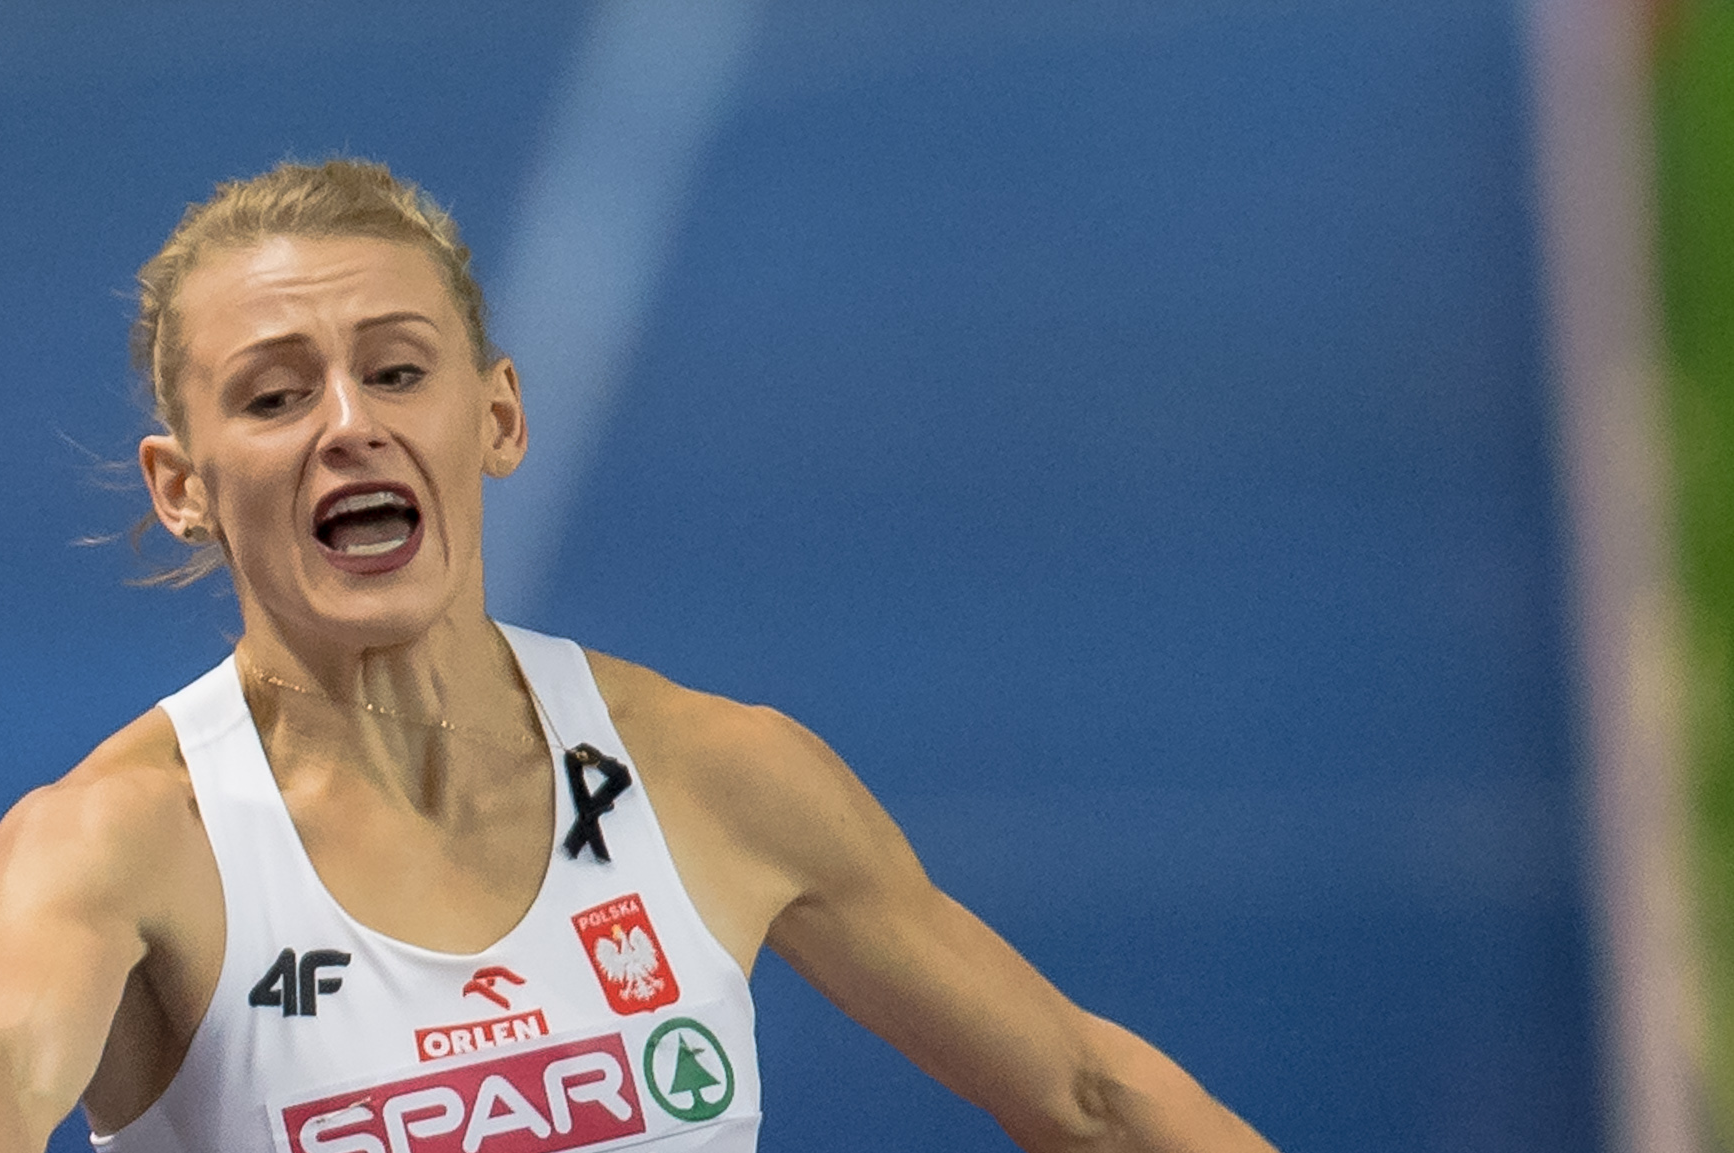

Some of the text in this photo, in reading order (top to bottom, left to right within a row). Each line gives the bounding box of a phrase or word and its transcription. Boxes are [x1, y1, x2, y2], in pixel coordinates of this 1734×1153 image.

[578, 898, 640, 932] POLSKA
[248, 947, 352, 1017] 4F
[422, 1014, 542, 1060] ORLEN
